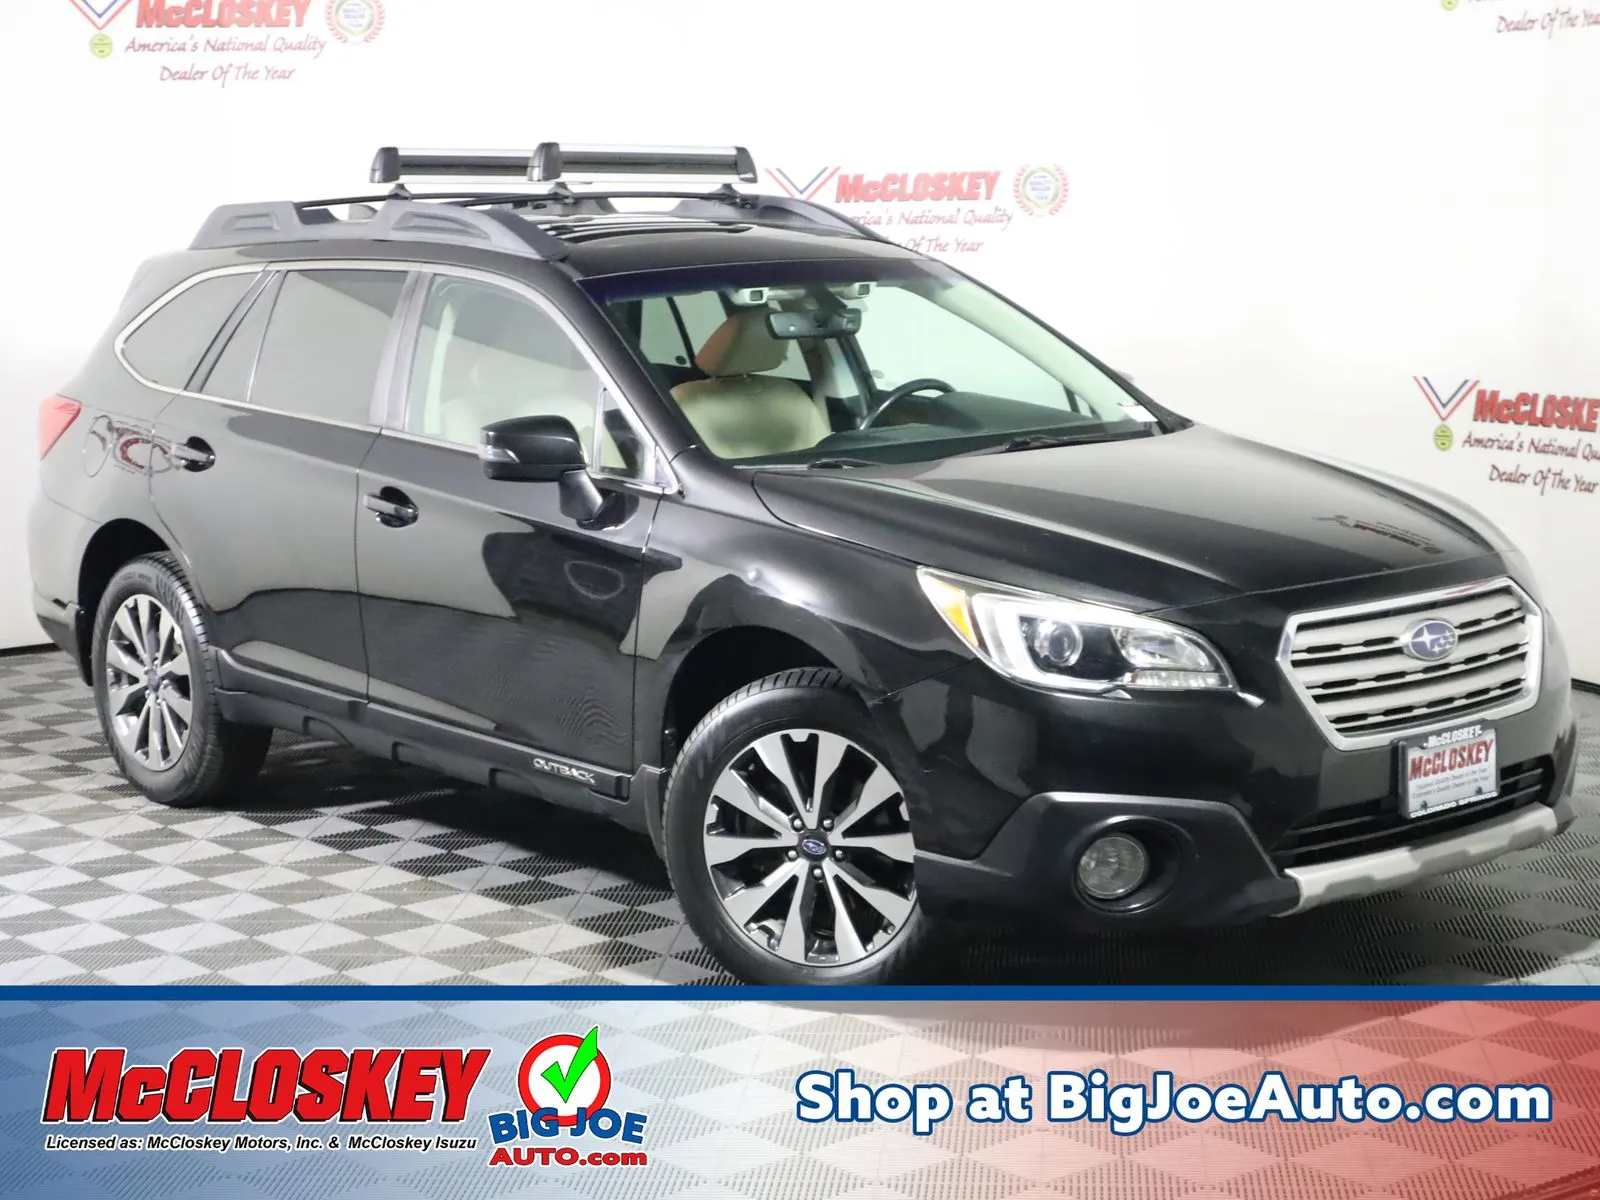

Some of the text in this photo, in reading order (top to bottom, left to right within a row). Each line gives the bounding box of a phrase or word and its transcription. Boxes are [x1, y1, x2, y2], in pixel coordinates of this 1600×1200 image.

[136, 0, 311, 28] McCLOSKEY
[1497, 11, 1538, 33] Dealer
[1582, 9, 1600, 28] Yea
[125, 34, 199, 53] America's
[204, 34, 270, 52] National
[273, 34, 326, 59] Quality
[160, 63, 296, 89] Dealer Of The Year
[836, 170, 1000, 203] McCLOSKEY
[898, 207, 959, 225] National
[964, 206, 1013, 231] Quality
[927, 236, 950, 252] The
[955, 238, 984, 253] Year
[1473, 389, 1600, 433] McCLOSKE
[1462, 431, 1524, 452] America's
[1528, 438, 1581, 458] National
[1489, 464, 1599, 496] Dealer Of The Year
[533, 758, 595, 784] OUTBACK
[1408, 739, 1494, 781] McCLOSKEY
